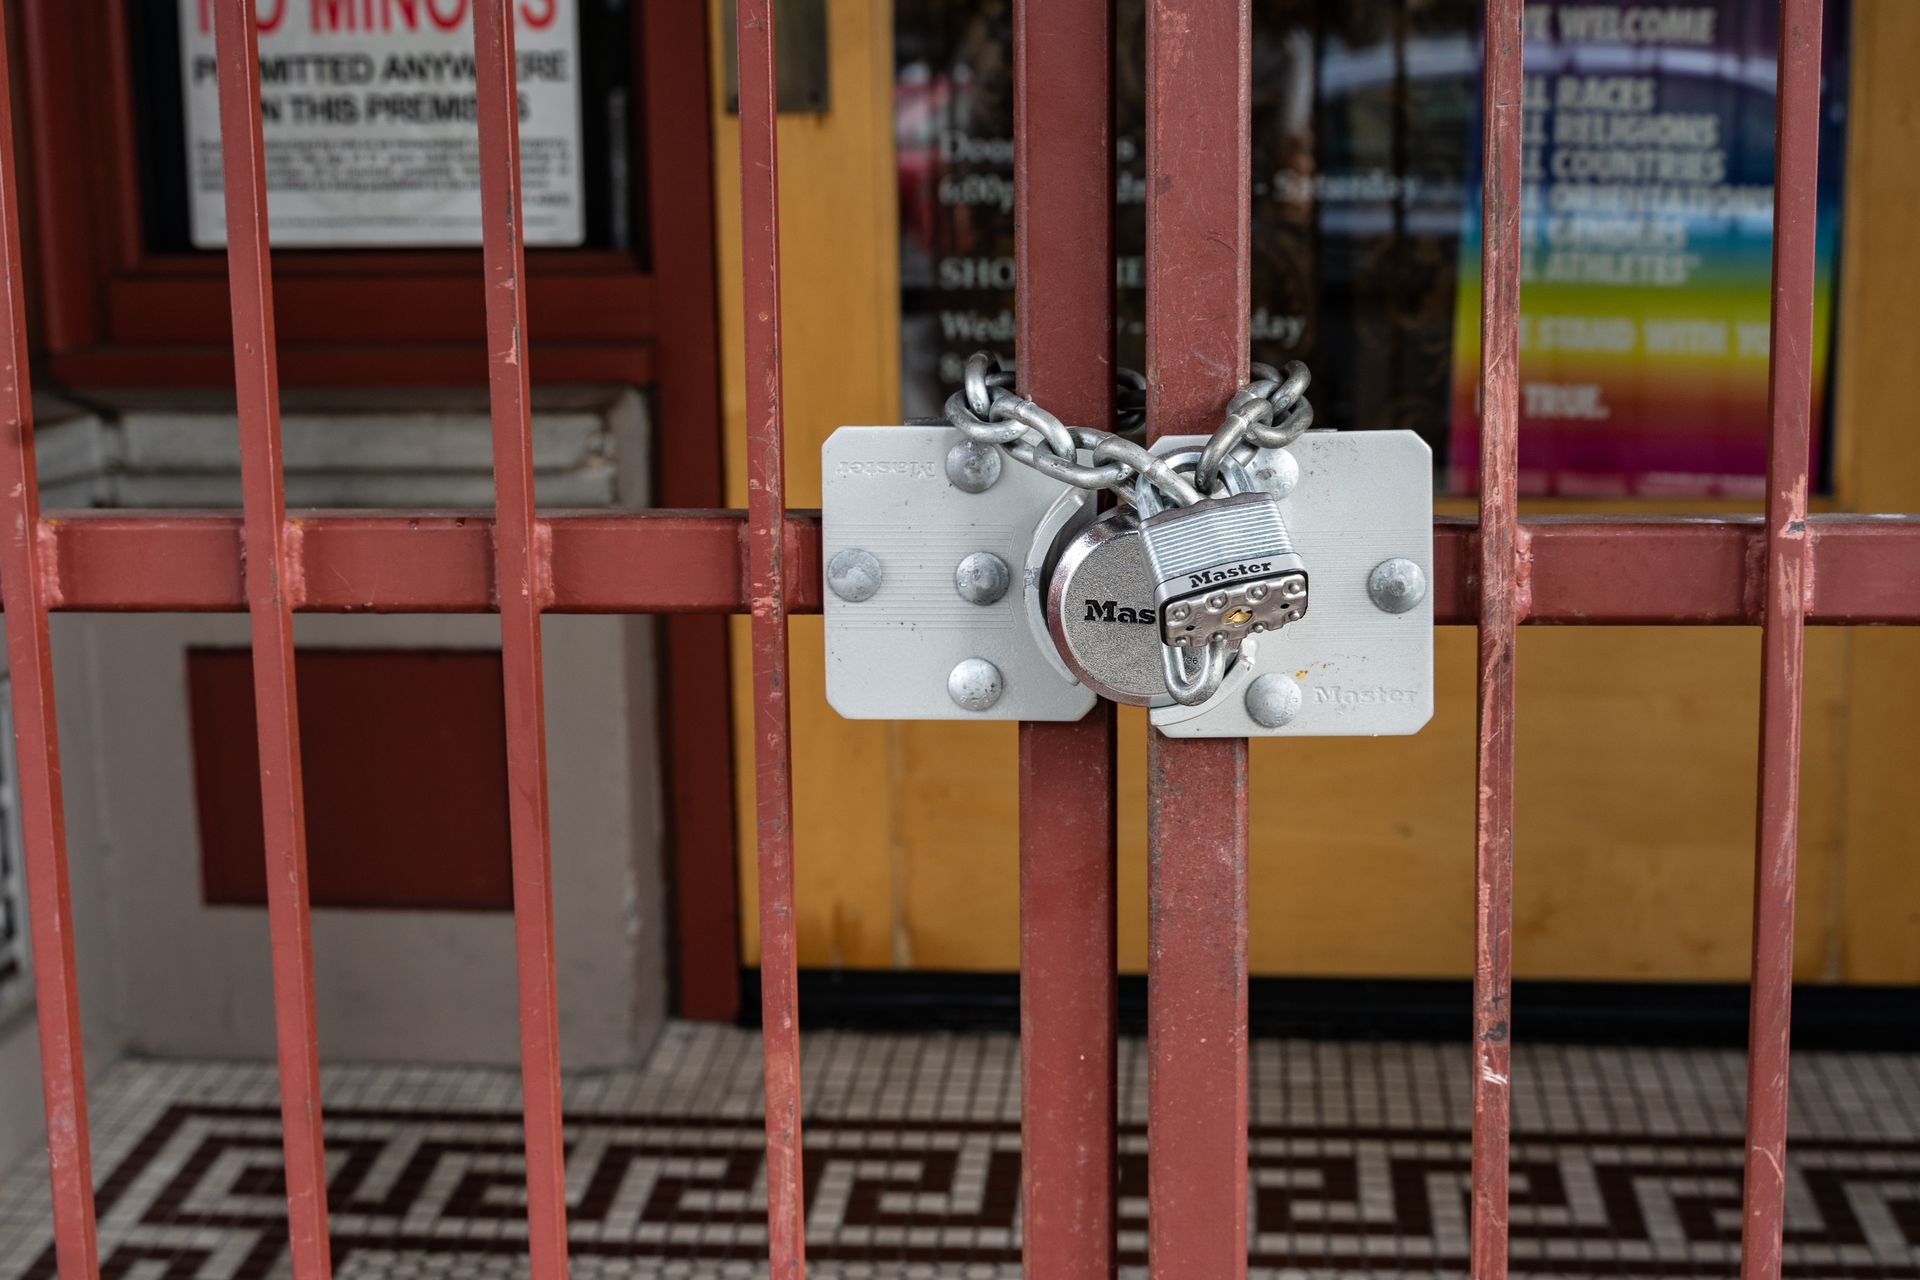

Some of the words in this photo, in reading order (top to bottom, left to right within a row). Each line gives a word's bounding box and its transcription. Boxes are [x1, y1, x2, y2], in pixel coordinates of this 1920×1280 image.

[1559, 8, 1718, 45] WELCOME
[291, 94, 359, 125] THIS
[1555, 78, 1656, 111] RACES
[1552, 114, 1720, 147] RELIGIONS
[1551, 148, 1728, 183] COUNTRIES
[1643, 320, 1727, 355] WITH
[1188, 562, 1272, 588] Master
[1084, 599, 1156, 625] Mas
[1313, 685, 1418, 705] Master
